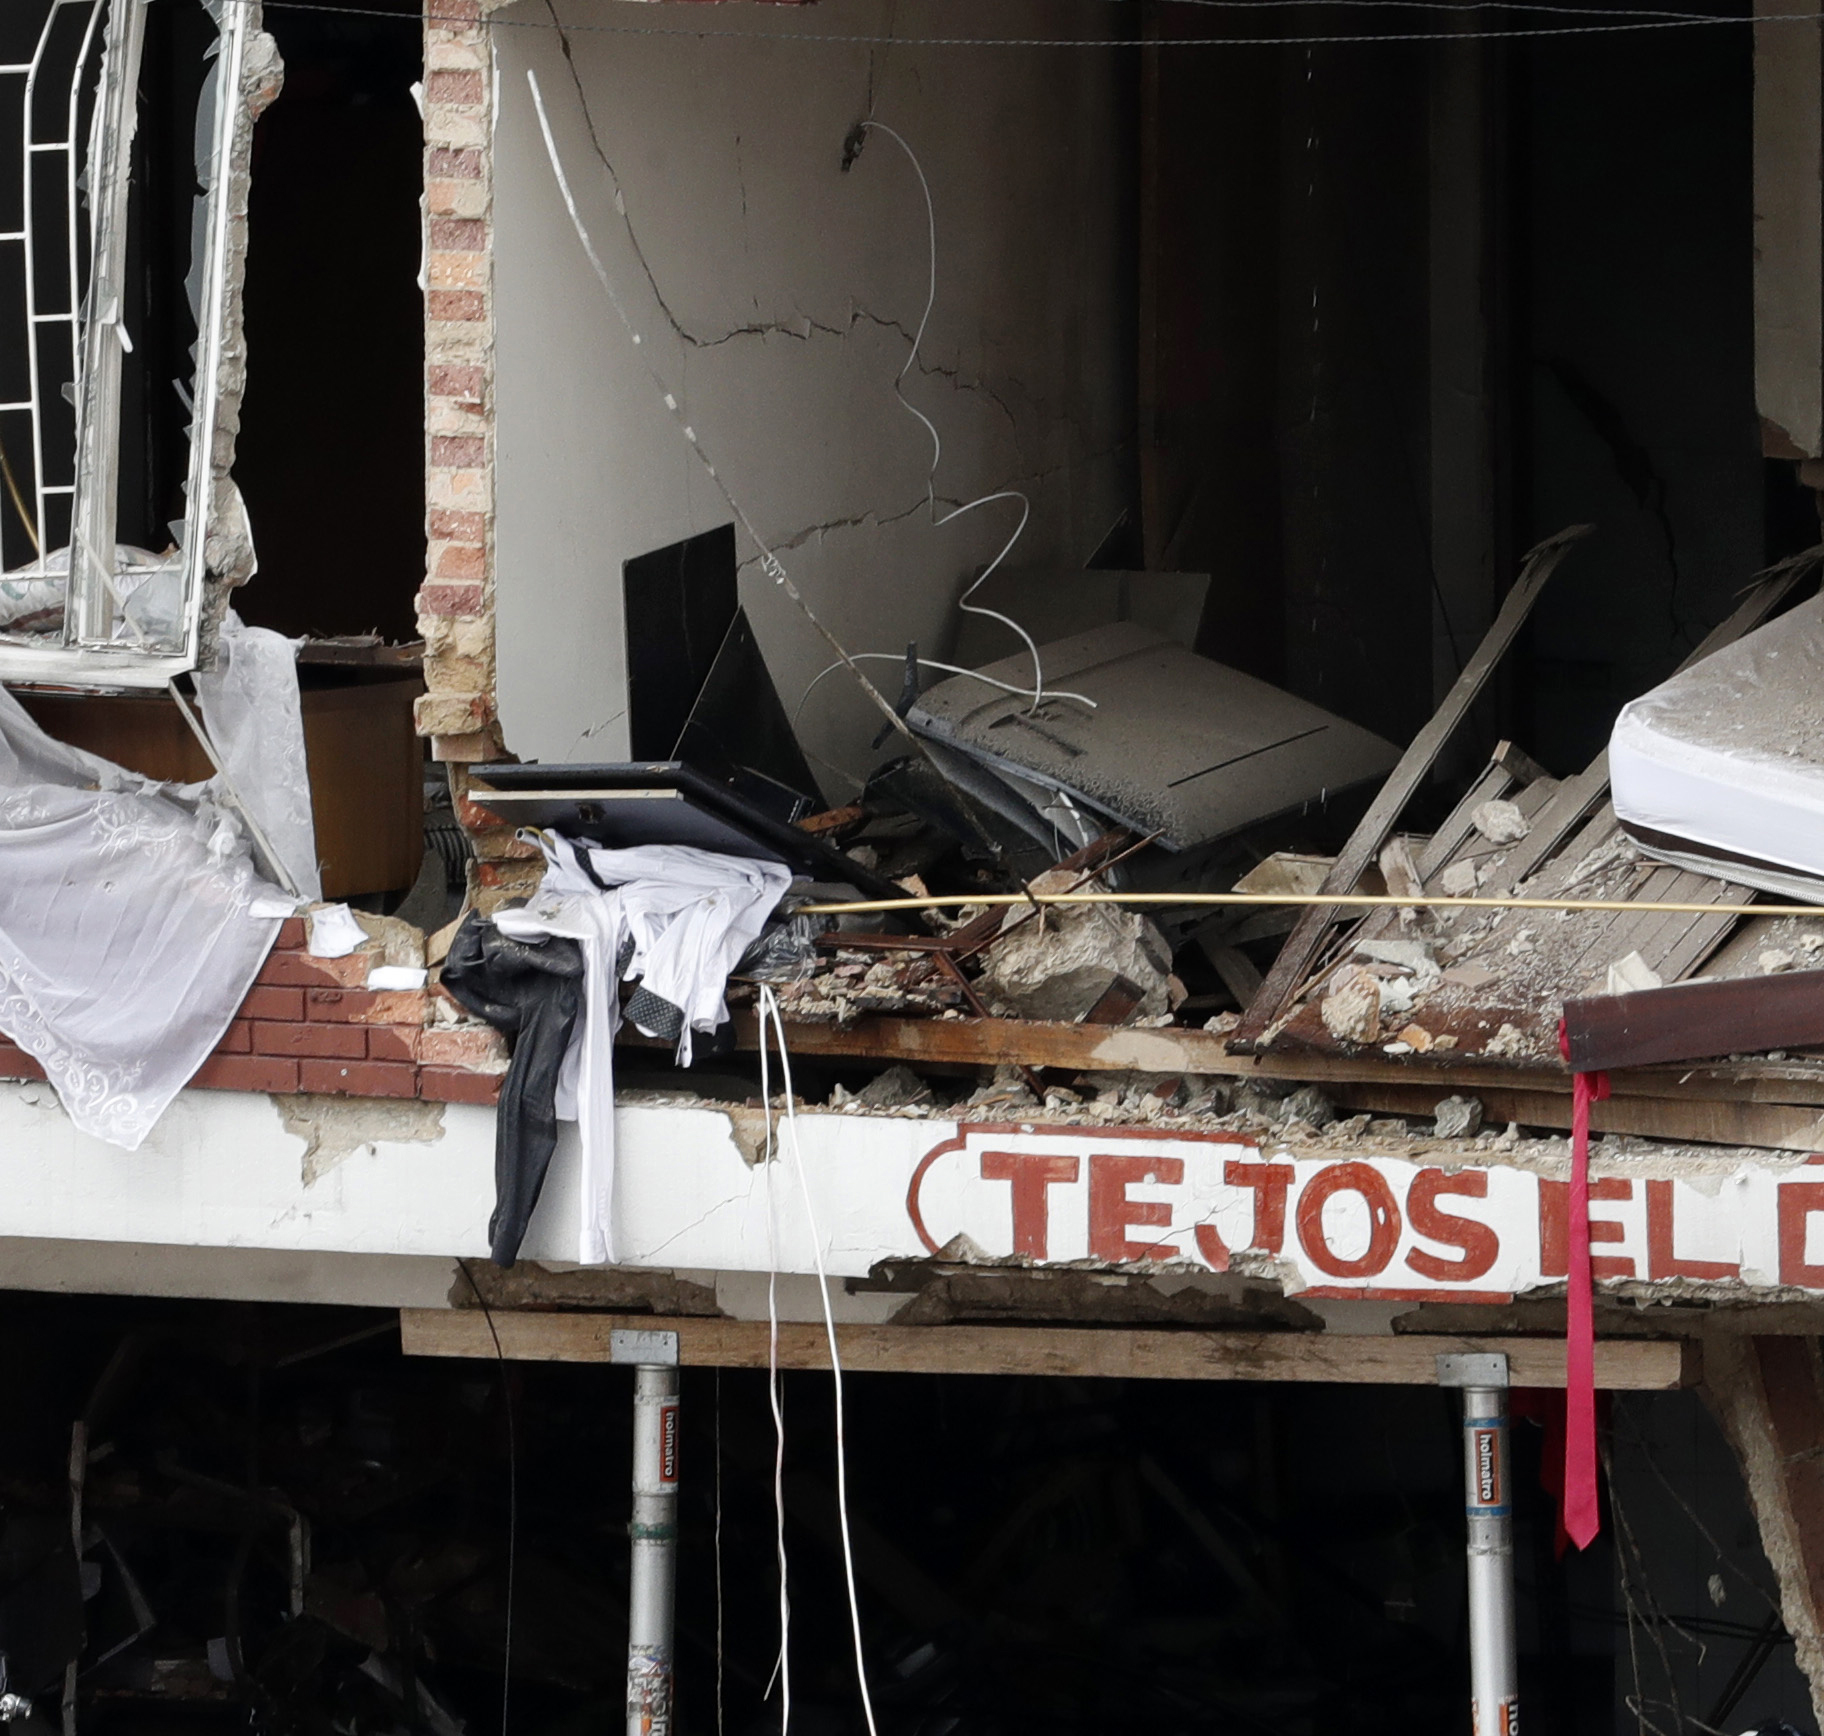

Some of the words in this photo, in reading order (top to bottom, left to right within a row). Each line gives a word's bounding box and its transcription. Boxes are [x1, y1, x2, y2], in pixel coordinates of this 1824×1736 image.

[980, 1150, 1501, 1283] TEJOS
[1539, 1176, 1740, 1280] EL
[665, 1411, 675, 1476] holmatro
[1480, 1434, 1493, 1500] holmatro
